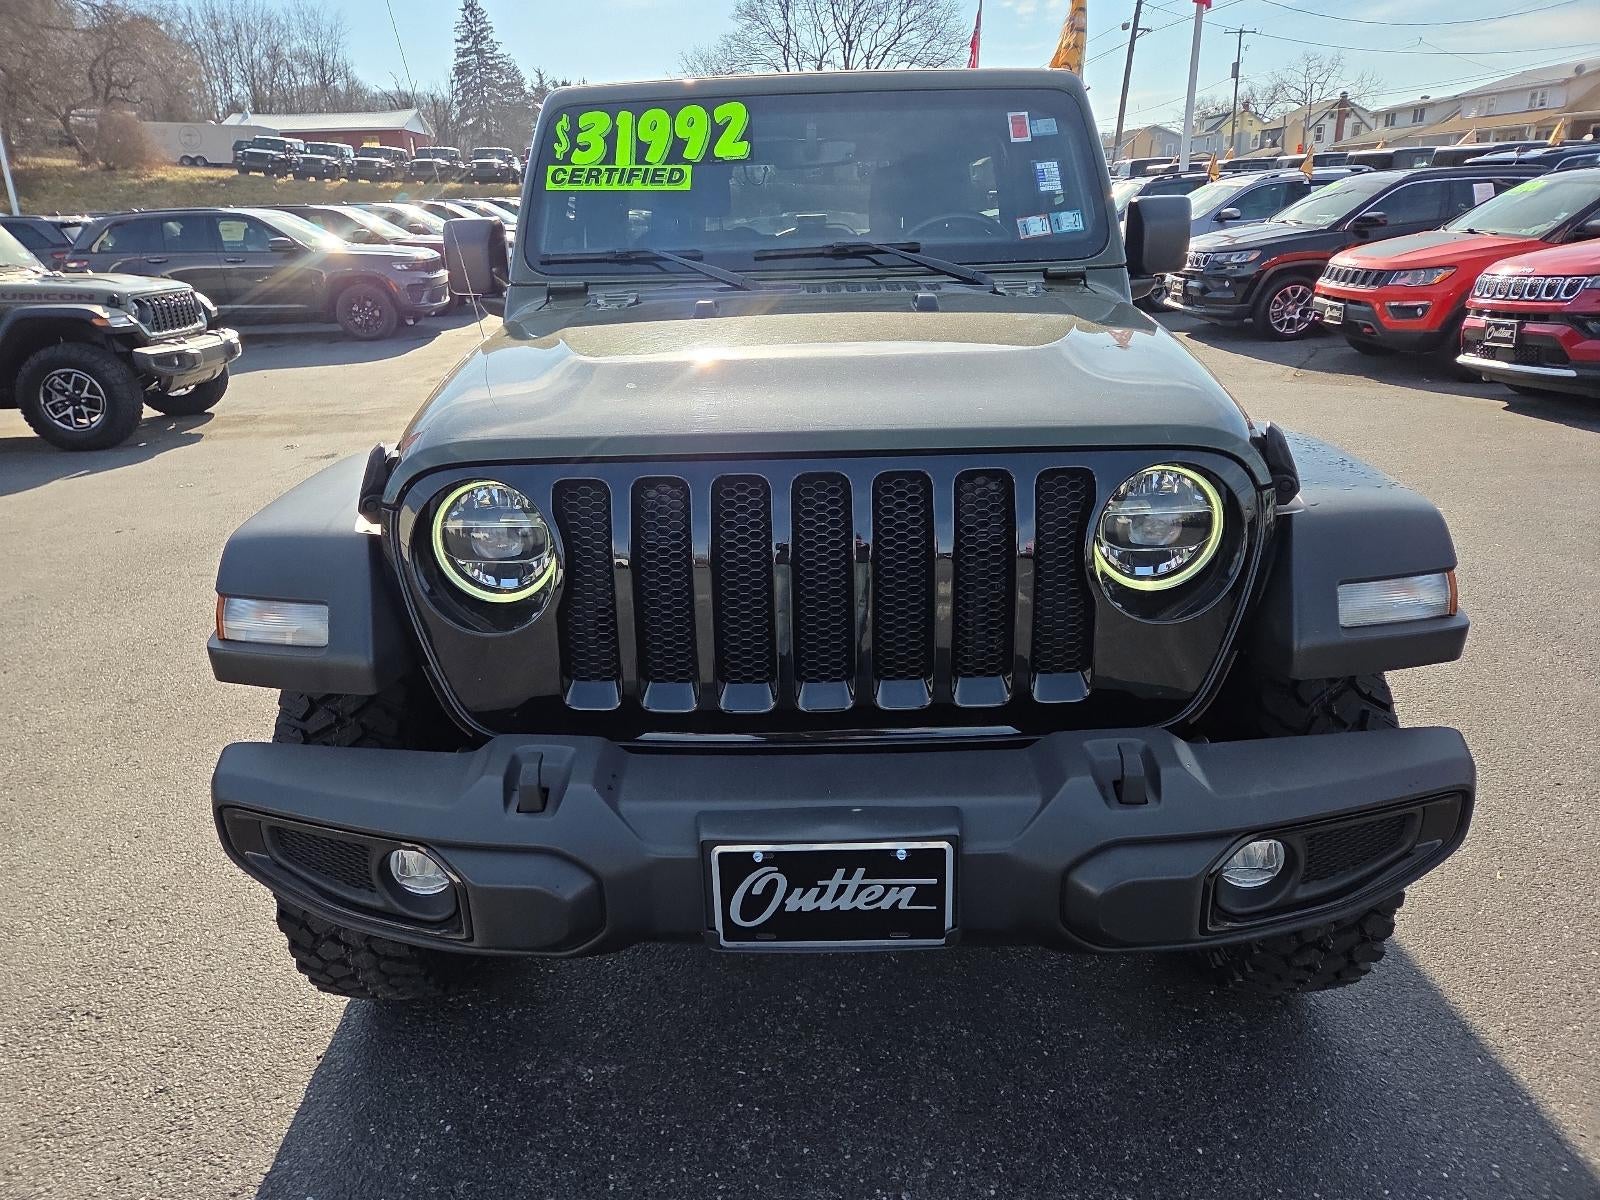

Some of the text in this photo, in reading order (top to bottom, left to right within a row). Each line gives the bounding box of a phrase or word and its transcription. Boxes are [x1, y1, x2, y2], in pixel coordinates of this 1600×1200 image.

[553, 102, 751, 166] $31992
[551, 167, 688, 188] CERTIFIED
[0, 292, 96, 301] UBICON
[729, 866, 938, 928] Outten
